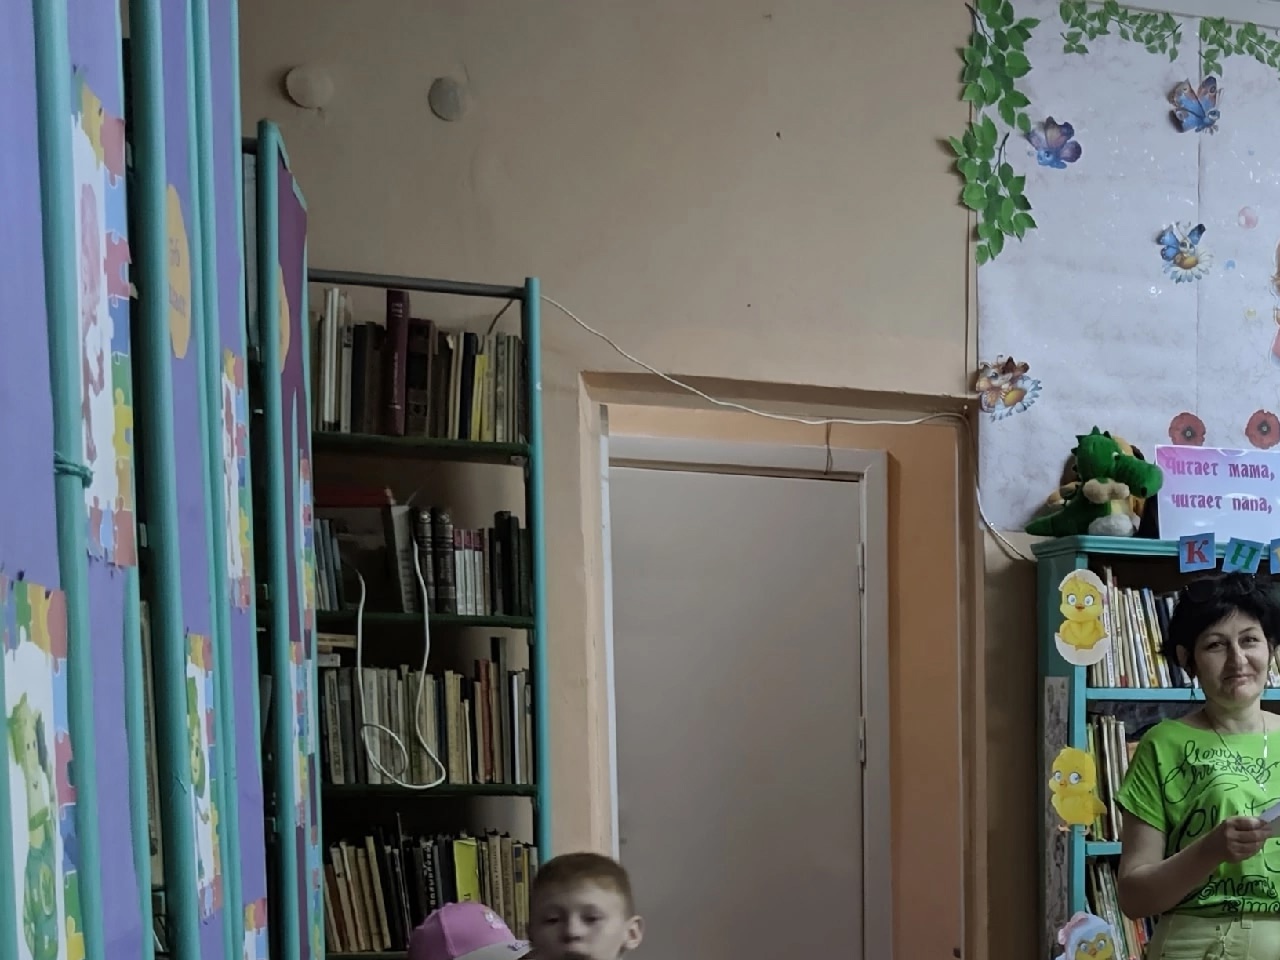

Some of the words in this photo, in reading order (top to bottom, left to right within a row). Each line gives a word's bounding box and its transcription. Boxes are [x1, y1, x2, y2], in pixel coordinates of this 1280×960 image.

[1165, 458, 1218, 476] Читает
[1229, 463, 1275, 481] мама,
[1171, 493, 1223, 510] читает
[1232, 496, 1273, 514] папа,
